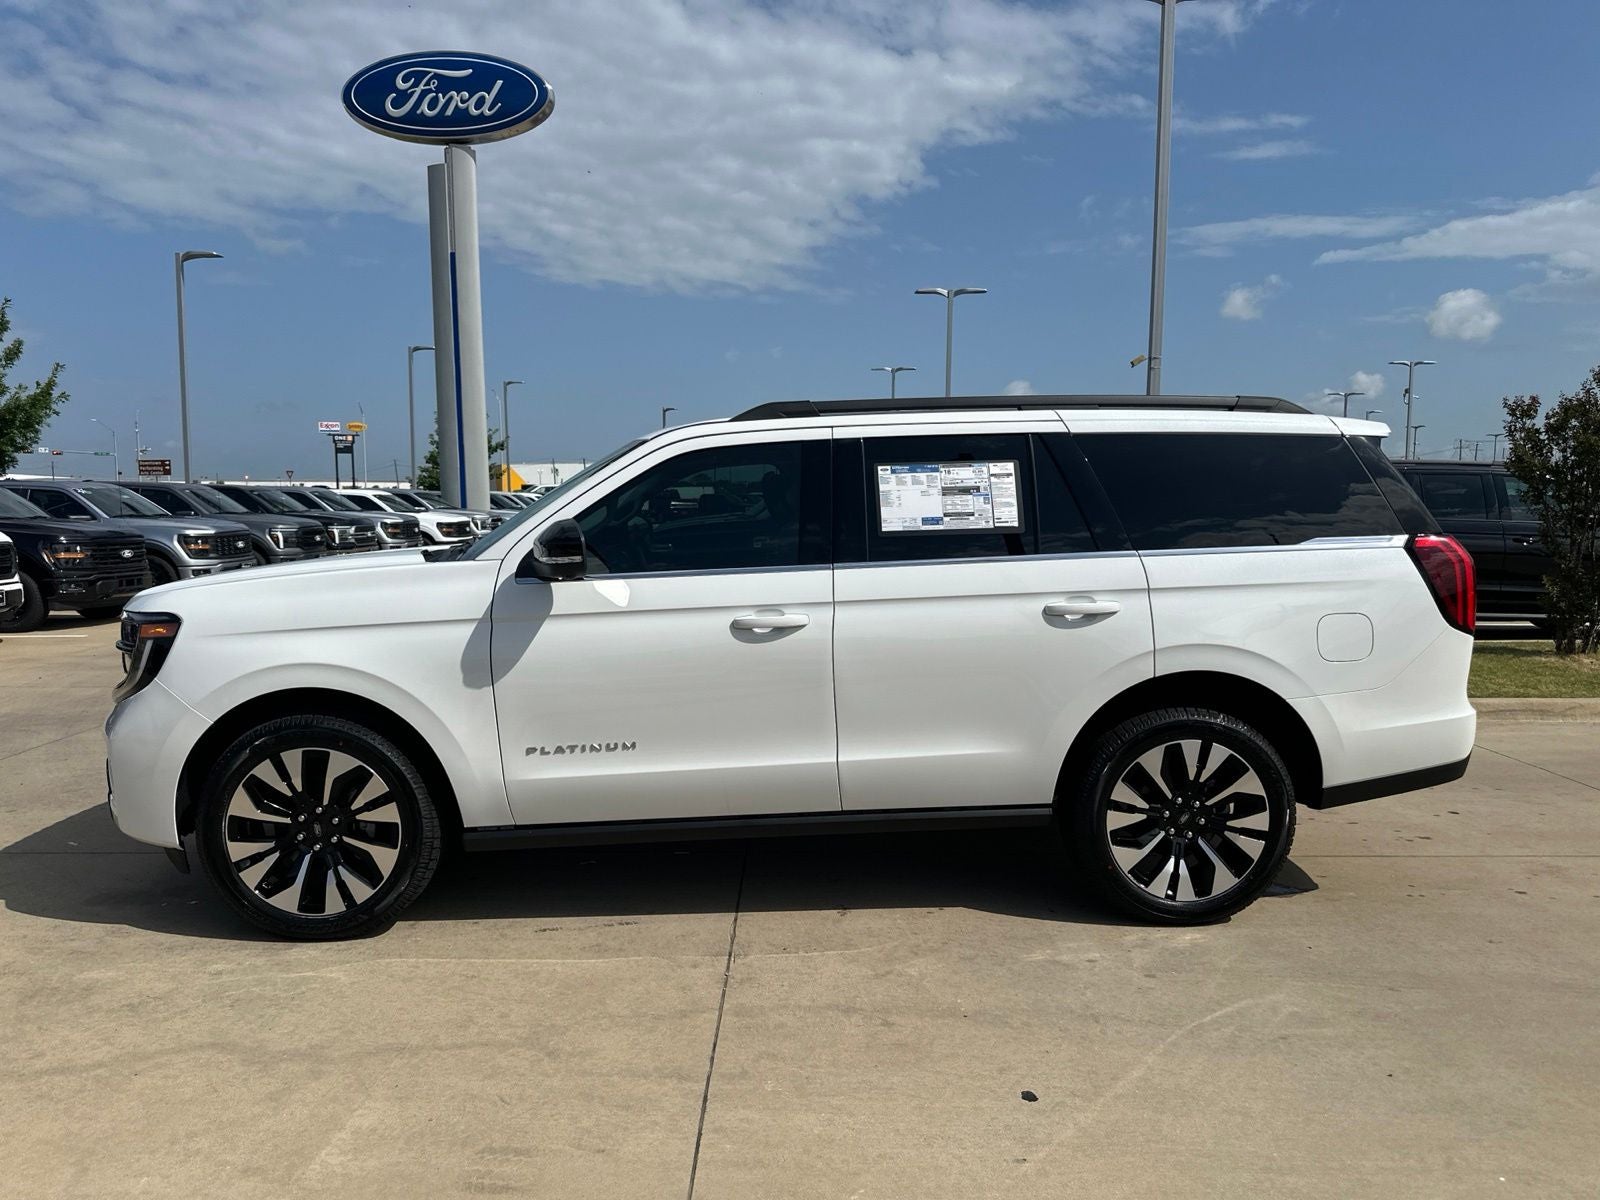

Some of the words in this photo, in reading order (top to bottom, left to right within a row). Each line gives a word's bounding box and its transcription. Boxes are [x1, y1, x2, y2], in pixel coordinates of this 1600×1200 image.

[384, 67, 504, 118] Ford
[320, 422, 340, 430] Exxon
[524, 741, 637, 757] PLATINUM
